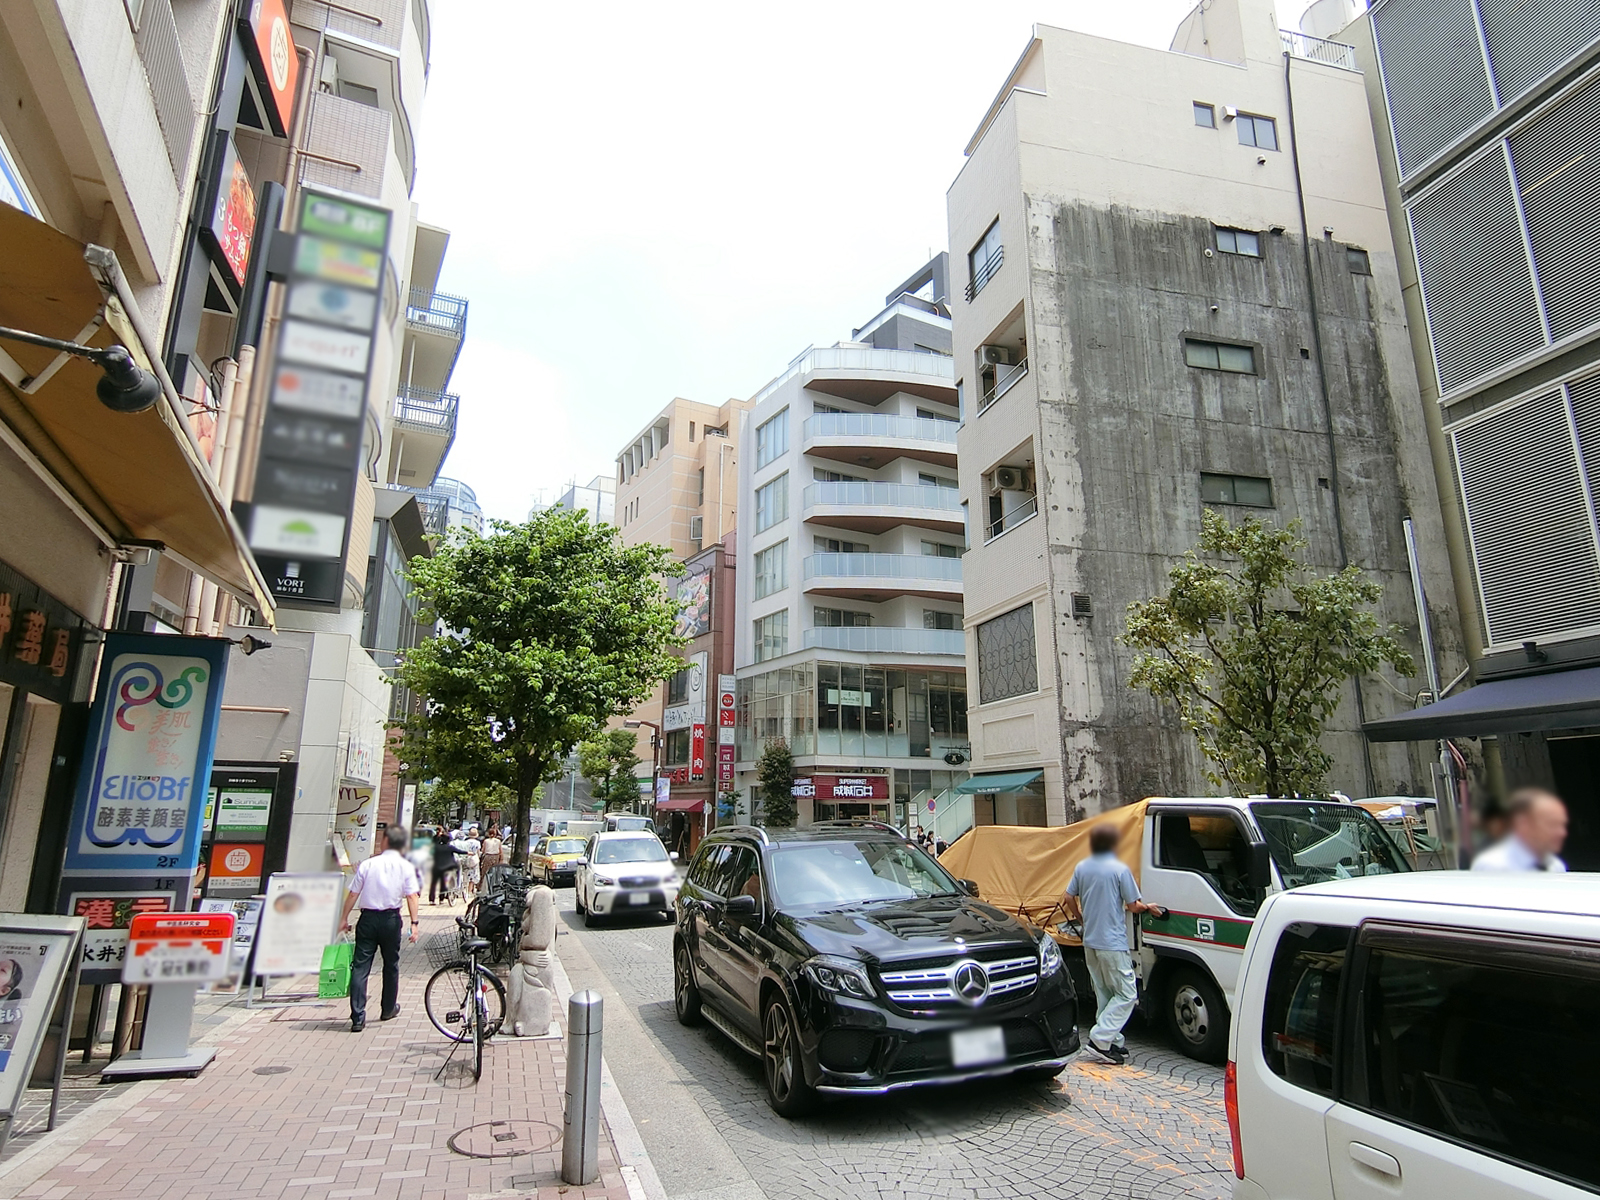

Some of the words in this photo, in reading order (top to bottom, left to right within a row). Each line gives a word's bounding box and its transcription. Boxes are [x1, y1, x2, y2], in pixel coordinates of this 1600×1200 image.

[218, 197, 226, 221] 3
[277, 578, 305, 588] VORT
[833, 786, 873, 797] 成城石井
[97, 806, 186, 828] 酵素美顔室
[157, 855, 179, 868] 2F
[154, 878, 175, 890] 1F
